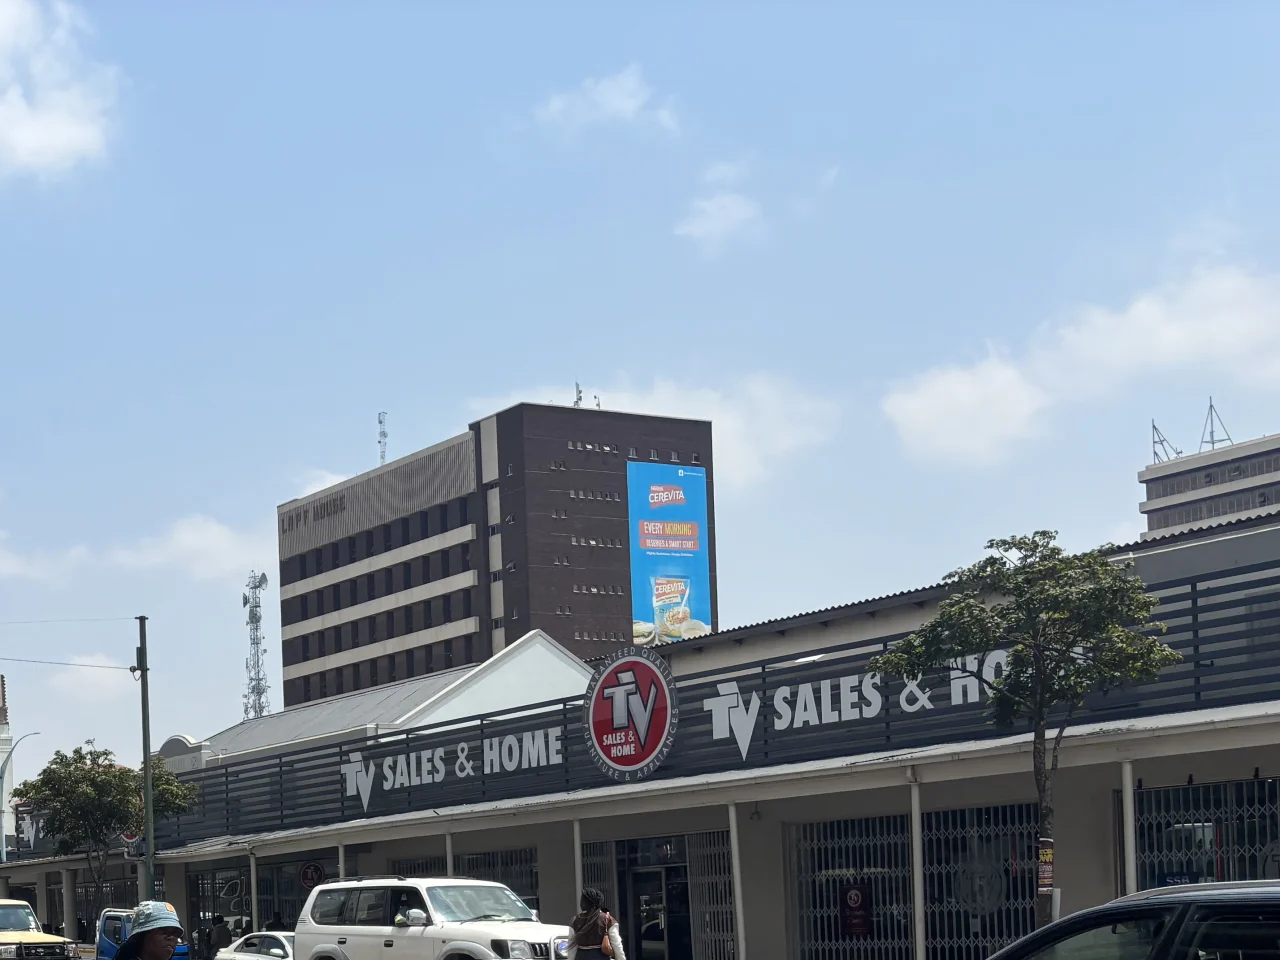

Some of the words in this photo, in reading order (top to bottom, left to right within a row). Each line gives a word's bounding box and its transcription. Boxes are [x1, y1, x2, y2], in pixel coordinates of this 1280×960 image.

[649, 489, 685, 504] CEREVITA
[644, 522, 664, 534] EVERY
[664, 523, 692, 536] MORNING
[669, 540, 682, 548] SMART
[654, 582, 685, 595] CEREVITA
[584, 646, 636, 707] GUARANTEED
[641, 649, 676, 689] QUALITY
[773, 672, 882, 731] SALES
[899, 669, 935, 713] &
[583, 723, 619, 780] FURNITURE
[625, 772, 631, 781] &
[637, 708, 679, 778] APPLIANCES
[603, 731, 626, 746] SALES
[628, 730, 635, 742] &
[611, 743, 636, 757] HOME
[382, 747, 446, 791] SALES
[454, 741, 475, 778] &
[483, 726, 563, 775] HOME
